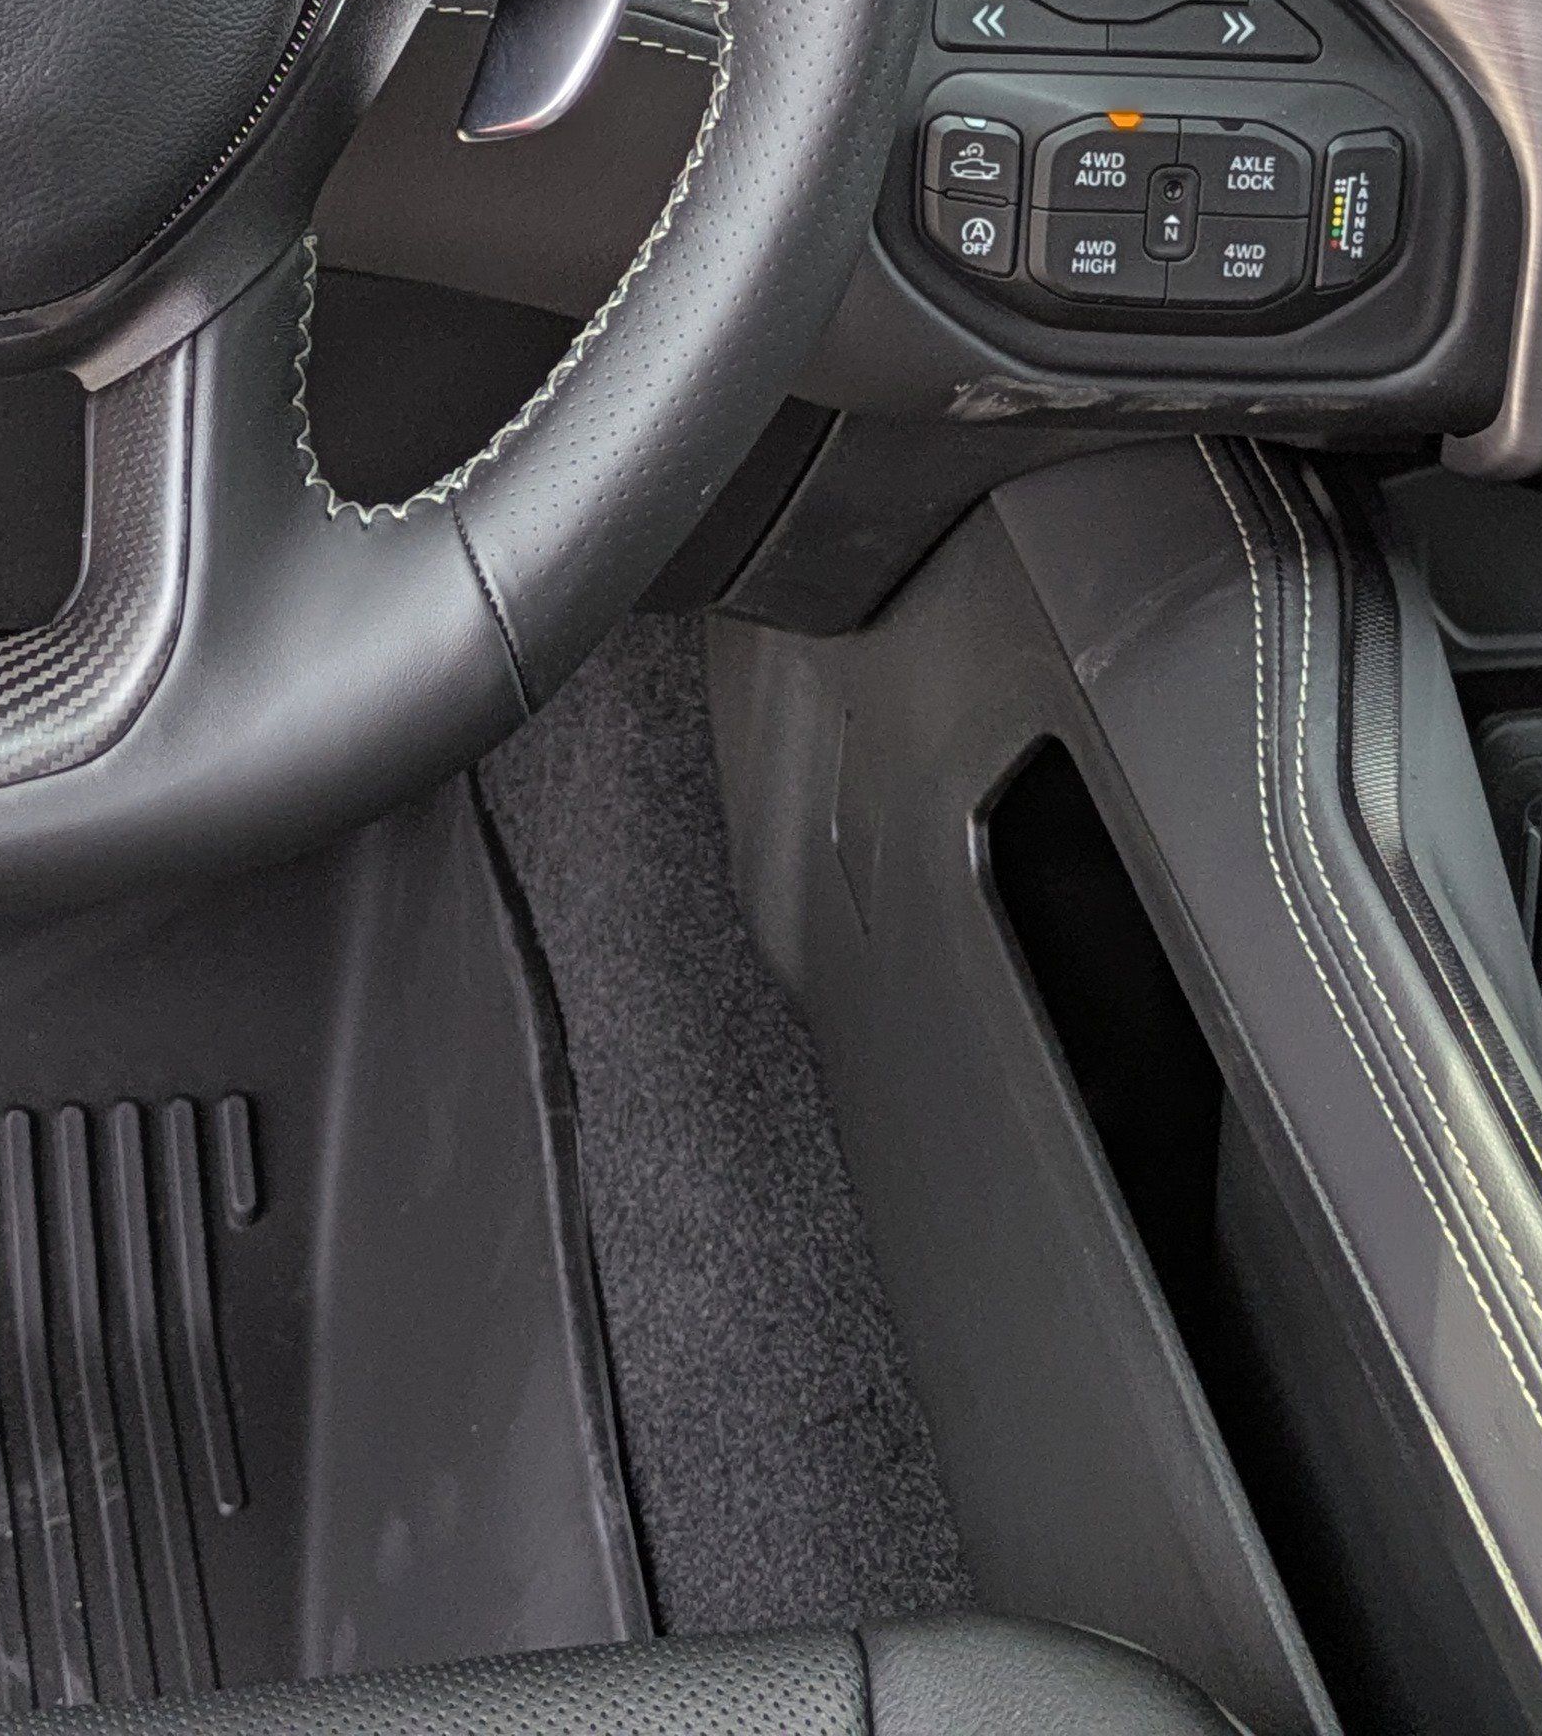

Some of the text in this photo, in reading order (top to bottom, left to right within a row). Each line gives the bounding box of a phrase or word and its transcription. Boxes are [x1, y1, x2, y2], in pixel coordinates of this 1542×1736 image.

[1079, 152, 1125, 170] 4WD
[1229, 156, 1277, 174] AXLE
[1075, 170, 1127, 189] AUTO
[1227, 173, 1276, 191] LOCK
[1165, 225, 1178, 243] N
[961, 241, 992, 257] OFF
[1074, 240, 1116, 257] 4WD
[1223, 243, 1266, 261] 4WD
[1071, 257, 1117, 275] HIGH
[1223, 260, 1263, 279] LOW
